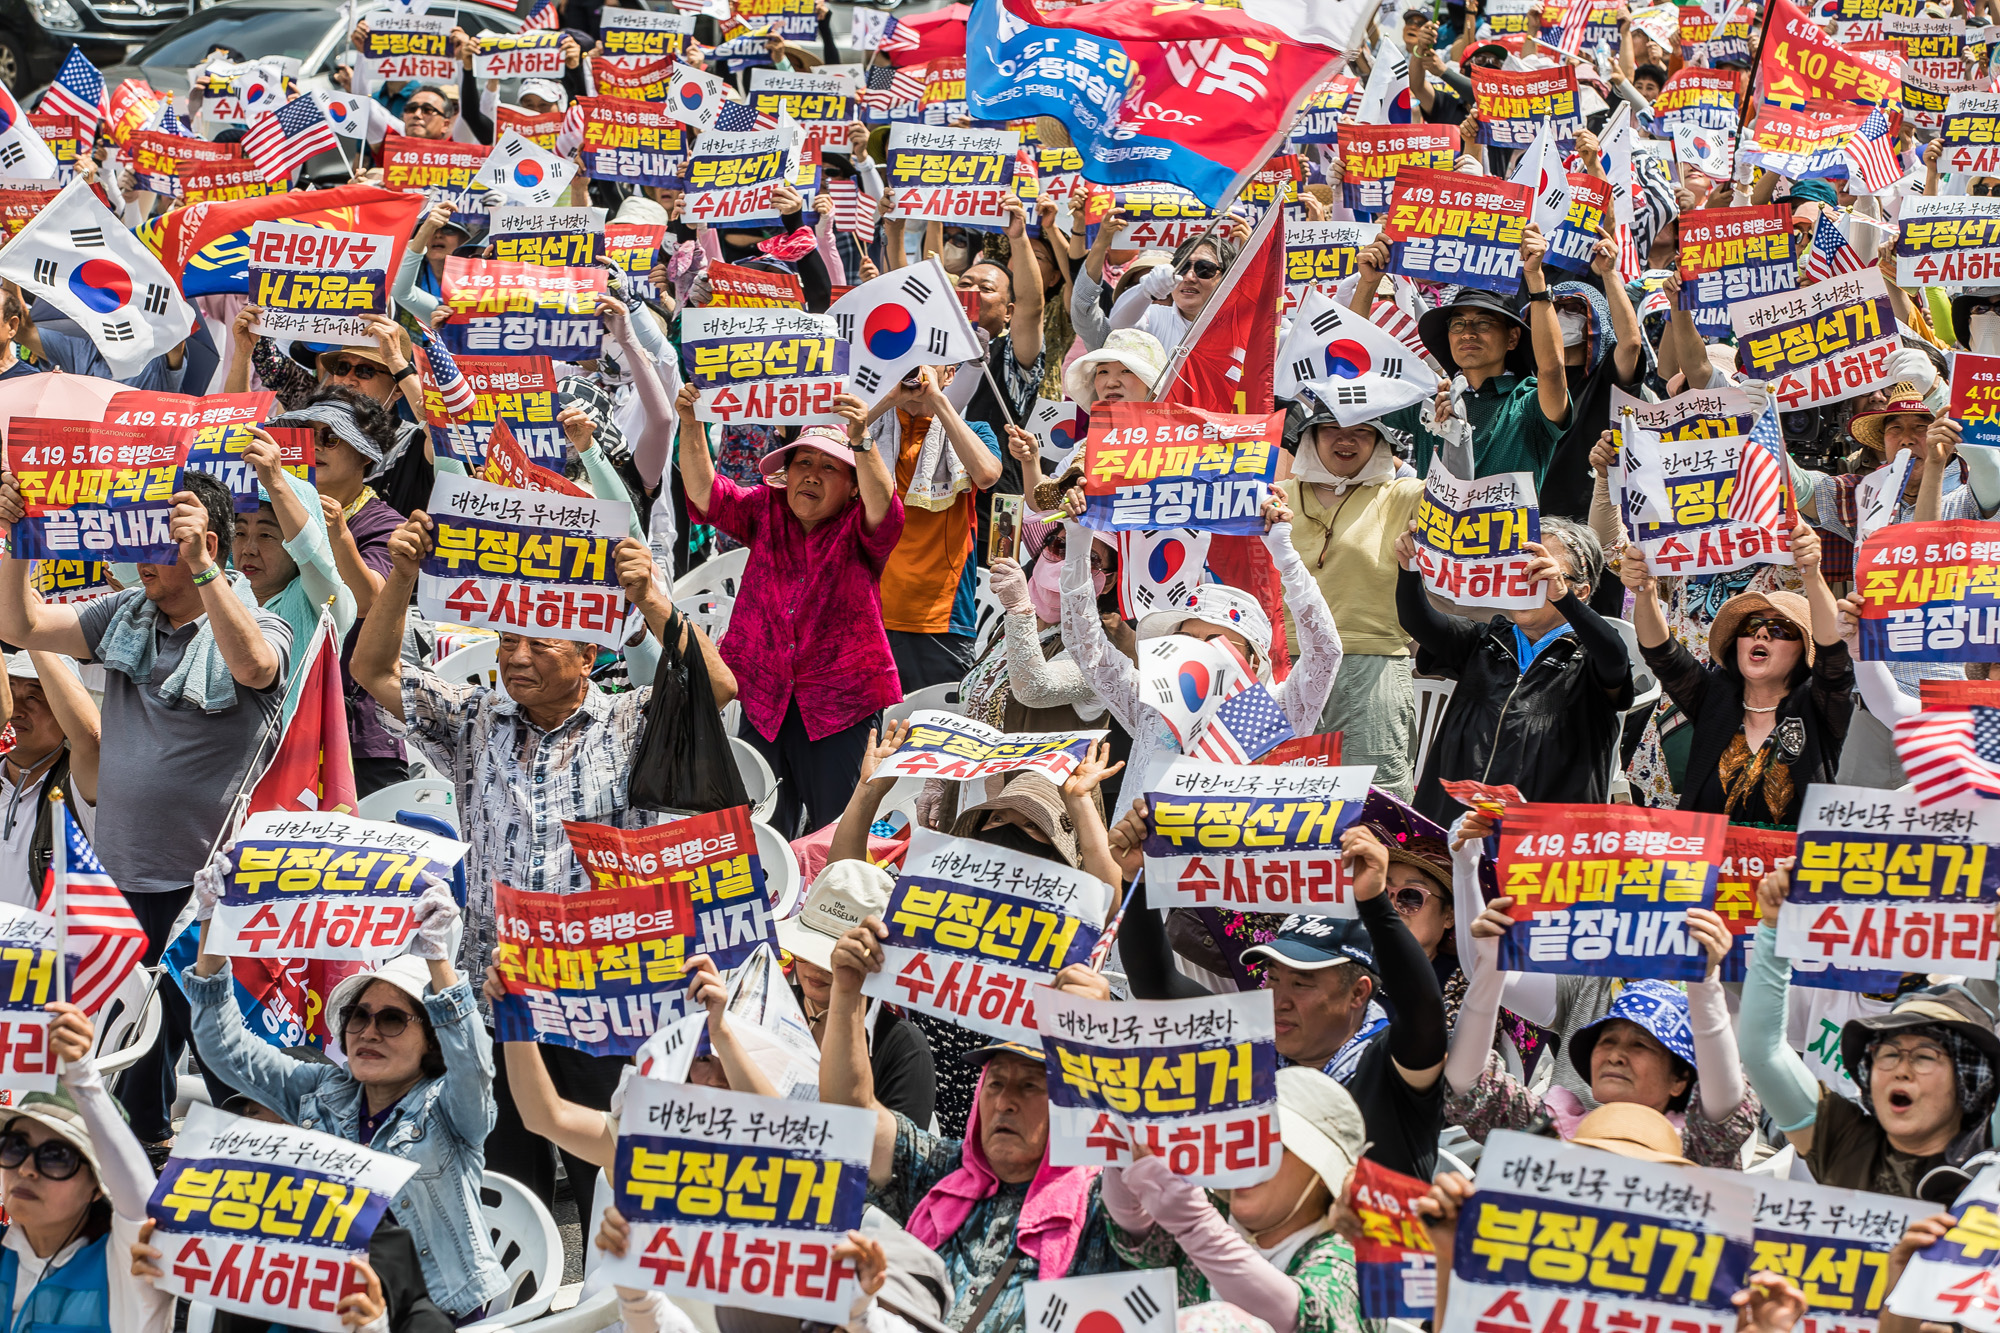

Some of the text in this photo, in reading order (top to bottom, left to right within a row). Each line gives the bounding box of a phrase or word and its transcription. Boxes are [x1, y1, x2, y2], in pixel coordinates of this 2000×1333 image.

[604, 31, 683, 54] 부정선거
[1785, 18, 1819, 46] 4.19,
[1893, 22, 1921, 33] 대한민국
[370, 33, 446, 55] 부정선거
[378, 58, 455, 79] 수사하라
[486, 52, 564, 74] 수사하라
[1774, 41, 1827, 79] 4.10
[765, 78, 803, 91] 대한민국
[1477, 79, 1568, 96] 4.19, 5.16 혁명으로
[1680, 77, 1733, 89] 5.16 혁명으로
[756, 94, 845, 119] 부정선거
[1478, 91, 1575, 117] 주사파척결
[1654, 88, 1737, 110] 주사파척결
[1959, 98, 2000, 112] 대한민국
[591, 107, 676, 127] 4.19, 5.16 혁명으로
[1663, 110, 1739, 132] 끝장내자
[1763, 120, 1821, 139] 4.19, 5.16
[584, 122, 681, 150] 주사파척결
[702, 134, 781, 152] 대한민국 무너졌다
[906, 132, 1003, 151] 대한민국 무너졌다
[1347, 135, 1450, 154] 4.19, 5.16 혁명으로
[167, 146, 192, 159] 5.16
[392, 153, 448, 165] 4.19, 5.16
[595, 149, 684, 176] 끝장내자
[893, 152, 1006, 183] 부정선거
[187, 172, 241, 189] 4.19, 5.16
[690, 150, 783, 187] 부정선거
[692, 184, 780, 219] 수사하라
[898, 188, 1007, 217] 수사하라
[1401, 188, 1526, 213] 4.19, 5.16 혁명으로
[1916, 202, 1966, 215] 대한민국
[501, 213, 590, 231] 대한민국 무너졌다
[1319, 227, 1362, 243] 무너졌다
[1391, 204, 1531, 243] 주사파척결
[1684, 218, 1783, 243] 4.19, 5.16 혁명으로
[248, 232, 377, 269] 수사하라
[496, 233, 594, 266] 부정선거
[1401, 235, 1524, 279] 끝장내자
[1681, 232, 1790, 271] 주사파척결
[257, 272, 376, 309] 부정선거
[454, 274, 594, 290] 4.19, 5.16 혁명으로
[733, 280, 795, 298] 5.16 혁명으로
[1697, 263, 1799, 303] 끝장내자
[449, 288, 601, 315] 주사파척결
[1749, 279, 1865, 327] 대한민국 무너졌다
[466, 316, 603, 350] 끝장내자
[704, 316, 828, 335] 대한민국 무너졌다
[1749, 298, 1882, 373] 부정선거
[694, 338, 836, 381] 부정선거
[490, 372, 544, 391] 혁명으로
[1972, 372, 1995, 382] 4.19,
[115, 406, 258, 427] 4.19, 5.16 혁명으로
[710, 381, 844, 422] 수사하라
[1675, 396, 1726, 418] 무너졌다
[1102, 421, 1267, 445] 4.19, 5.16 혁명으로
[22, 443, 177, 467] 4.19, 5.16 혁명으로
[1091, 441, 1271, 482] 주사파척결
[17, 463, 178, 507] 주사파척결
[1462, 482, 1520, 506] 무너졌다
[451, 491, 600, 530] 대한민국 무너졌다
[1111, 481, 1267, 525] 끝장내자
[44, 508, 178, 551] 끝장내자
[1417, 498, 1528, 556] 부정선거
[434, 523, 610, 581] 부정선거
[1872, 541, 1967, 565] 4.19, 5.16
[445, 579, 624, 634] 수사하라
[1175, 772, 1341, 797] 대한민국 무너졌다
[1154, 800, 1345, 847] 부정선거
[1819, 801, 1978, 833] 대한민국 무너졌다
[265, 821, 430, 850] 대한민국 무너졌다
[1515, 830, 1705, 857] 4.19, 5.16 혁명으로
[586, 849, 624, 873] 4.19,
[624, 853, 657, 875] 5.16
[660, 832, 739, 868] 혁명으로
[1719, 856, 1766, 877] 4.19,
[234, 847, 432, 894] 부정선거
[931, 851, 1079, 903] 대한민국 무너졌다
[1177, 857, 1353, 904] 수사하라
[1505, 858, 1709, 905] 주사파척결
[1797, 841, 1988, 898] 부정선거
[818, 903, 859, 924] CLASSEUM
[834, 901, 846, 910] the
[237, 901, 422, 953] 수사하라
[496, 909, 675, 946] 4.19, 5.16 혁명으로
[892, 885, 1082, 969] 부정선거
[1529, 909, 1700, 962] 끝장내자
[1808, 905, 1999, 960] 수사하라
[498, 934, 686, 991] 주사파척결
[1057, 1008, 1238, 1045] 대한민국 무너졌다
[1056, 1042, 1253, 1113] 부정선거
[648, 1100, 833, 1146] 대한민국 무너졌다
[209, 1131, 372, 1174] 대한민국 무너졌다
[625, 1147, 842, 1225] 부정선거
[1502, 1156, 1716, 1219] 대한민국 무너졌다
[162, 1167, 371, 1243] 부정선거
[1822, 1204, 1909, 1240] 무너졌다
[639, 1227, 856, 1302] 수사하라
[1472, 1203, 1725, 1303] 부정선거
[173, 1238, 369, 1315] 수사하라
